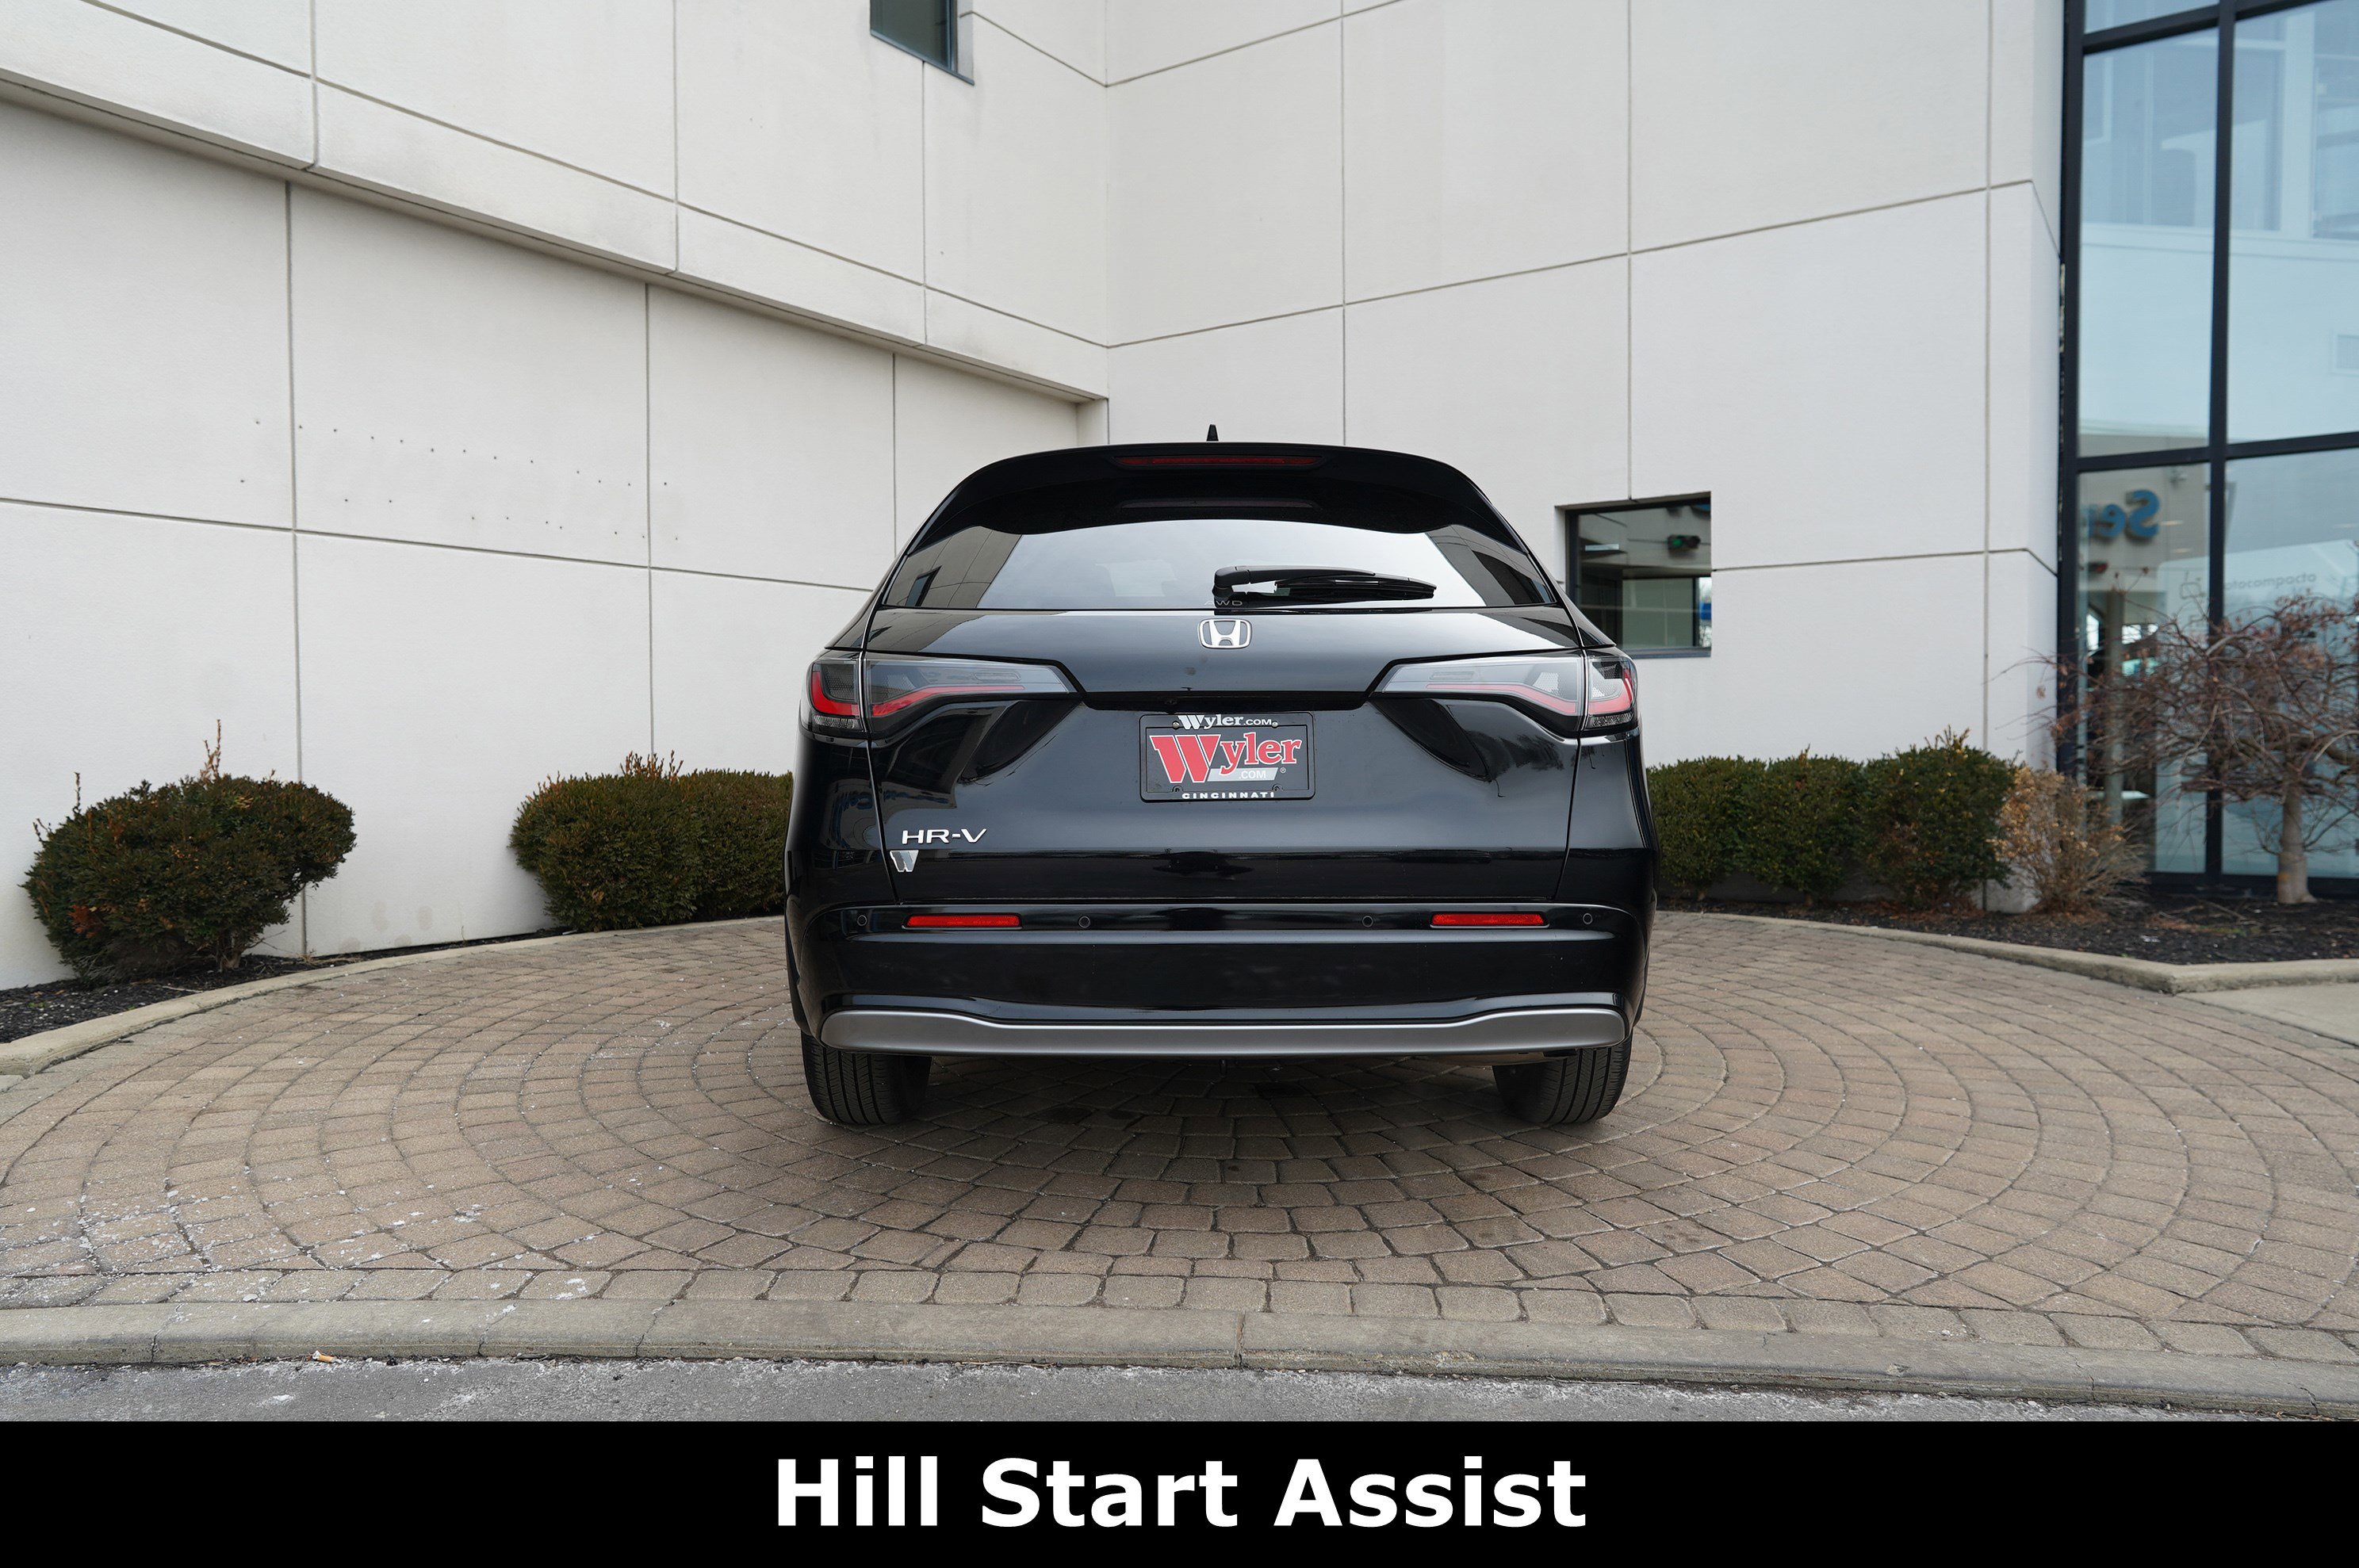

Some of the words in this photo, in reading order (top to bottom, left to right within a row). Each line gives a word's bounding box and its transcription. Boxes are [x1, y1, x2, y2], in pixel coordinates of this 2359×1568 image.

[2225, 572, 2317, 591] otocompacto
[1150, 732, 1302, 783] Wyler
[1181, 791, 1274, 800] CINCINNATI
[902, 828, 987, 845] HR-V
